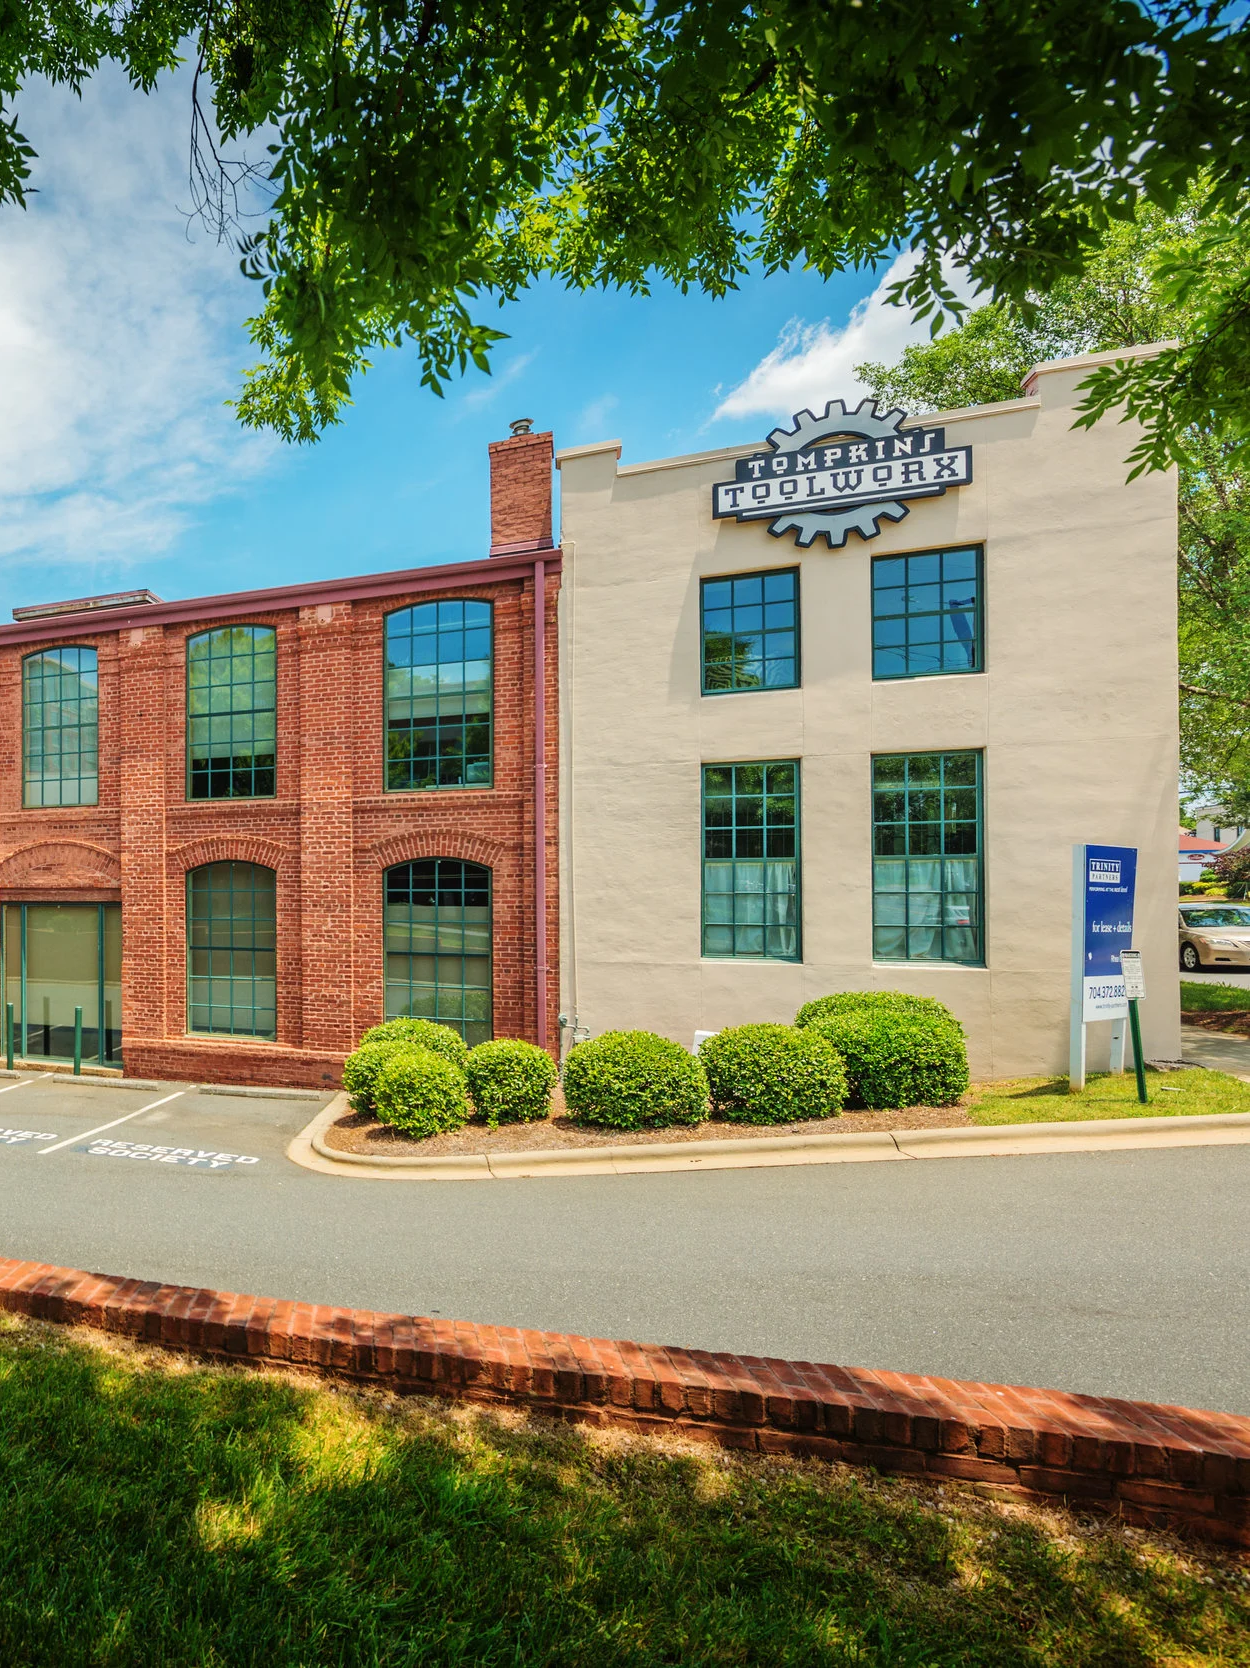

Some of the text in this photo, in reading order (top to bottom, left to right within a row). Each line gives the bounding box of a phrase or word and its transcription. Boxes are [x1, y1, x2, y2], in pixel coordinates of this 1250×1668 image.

[748, 432, 936, 479] TOMPKINS
[724, 454, 959, 509] TOOLWORX
[1091, 861, 1120, 872] TRINITY
[1092, 873, 1119, 881] PARTNERS
[1092, 920, 1100, 933] for
[1100, 920, 1112, 933] lease
[1088, 985, 1126, 999] 704.372.882
[87, 1147, 230, 1168] SOCIETY
[90, 1138, 260, 1164] RESERVED
